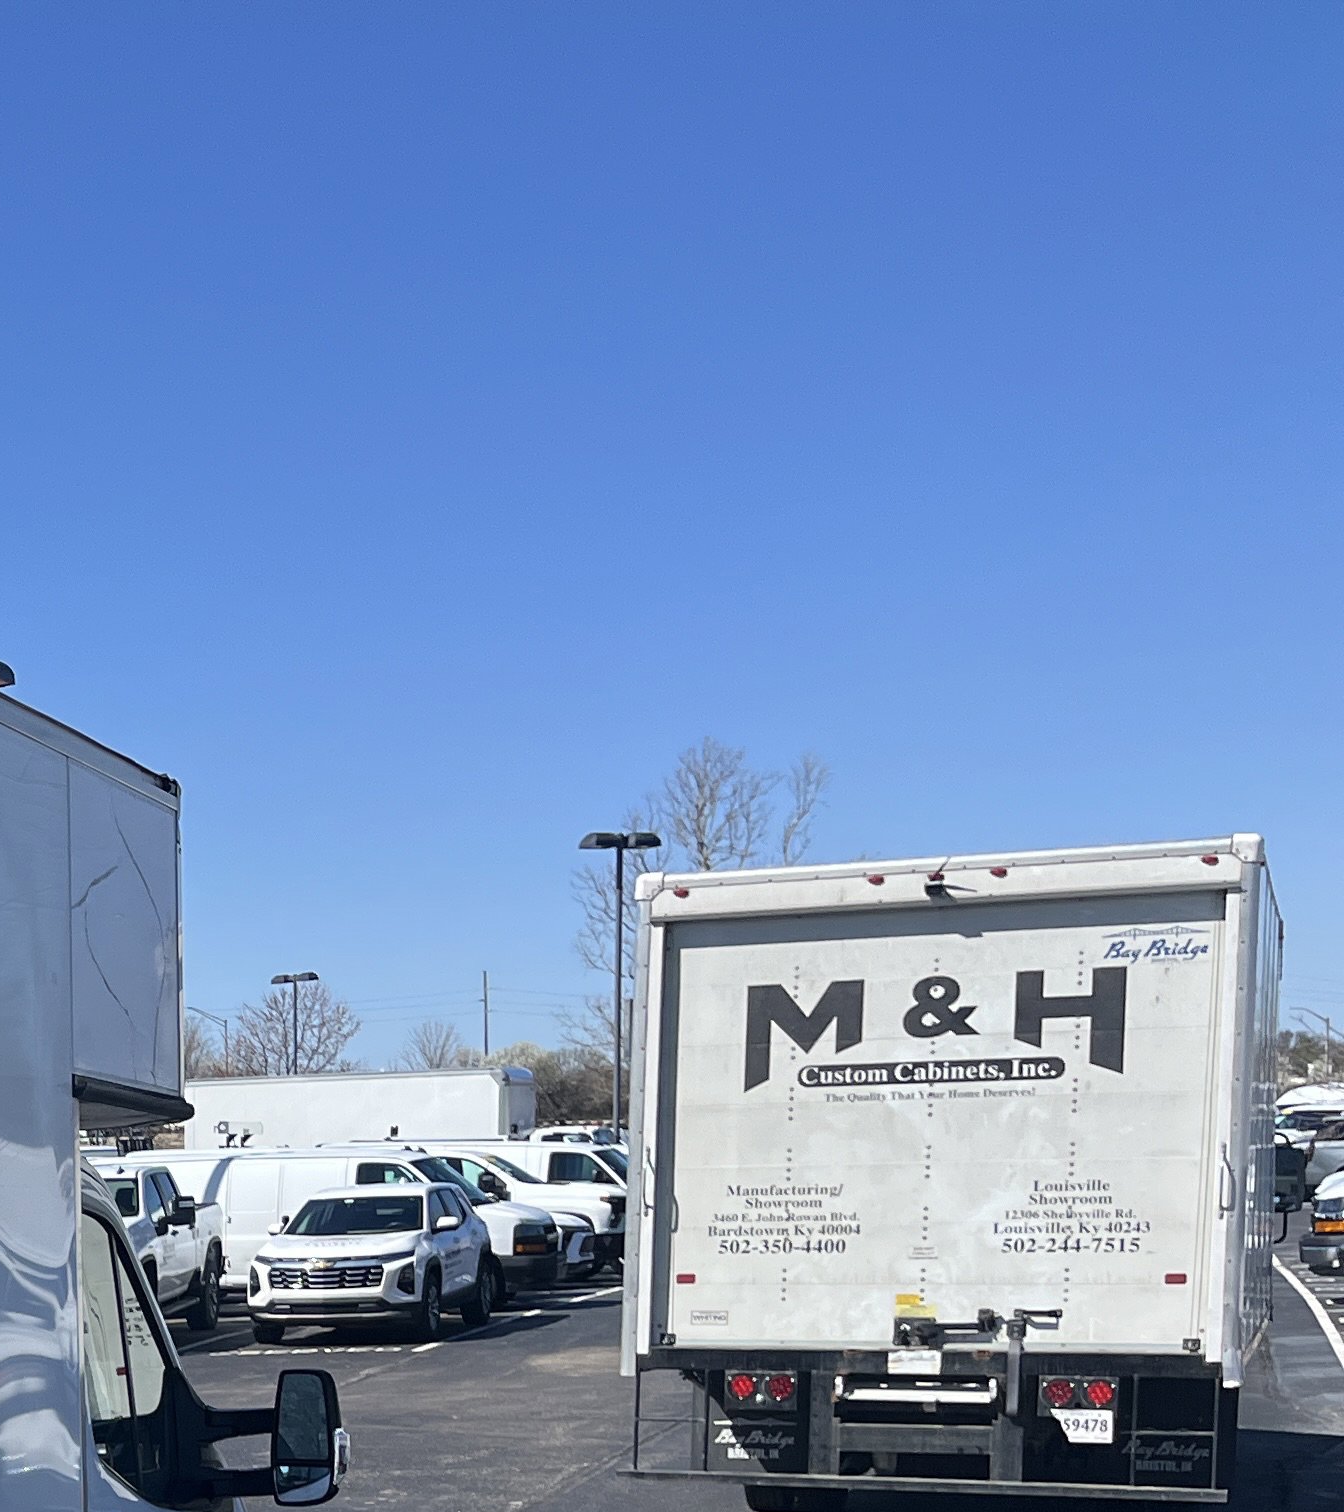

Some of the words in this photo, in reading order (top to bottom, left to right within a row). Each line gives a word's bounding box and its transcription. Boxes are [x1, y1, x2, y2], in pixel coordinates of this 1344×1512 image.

[1103, 940, 1142, 964] Bay
[1144, 938, 1209, 960] Bridge
[744, 979, 865, 1092] M
[902, 975, 981, 1038] &
[1014, 966, 1128, 1075] H
[799, 1066, 889, 1086] Custom
[893, 1061, 1005, 1082] Cabinets,
[1011, 1058, 1058, 1078] Inc.
[825, 1093, 845, 1103] The
[847, 1091, 886, 1104] Quality
[891, 1091, 914, 1101] That
[919, 1090, 945, 1100] Your
[948, 1089, 980, 1099] Home
[726, 1183, 844, 1197] Manufacturing/
[1033, 1179, 1110, 1192] Louisville
[744, 1198, 823, 1210] Showroom
[1028, 1194, 1113, 1206] Showroom
[755, 1213, 785, 1223] John
[830, 1211, 861, 1222] Blvd.
[1005, 1210, 1040, 1220] 12306
[1115, 1208, 1137, 1219] Rd.
[794, 1225, 814, 1239] Ky
[818, 1224, 861, 1236] 40004
[1078, 1223, 1102, 1237] Ky
[1104, 1221, 1151, 1234] 40243
[717, 1239, 847, 1255] 502-350-4400
[1001, 1237, 1141, 1254] 502-244-7515
[1063, 1418, 1108, 1432] 59478
